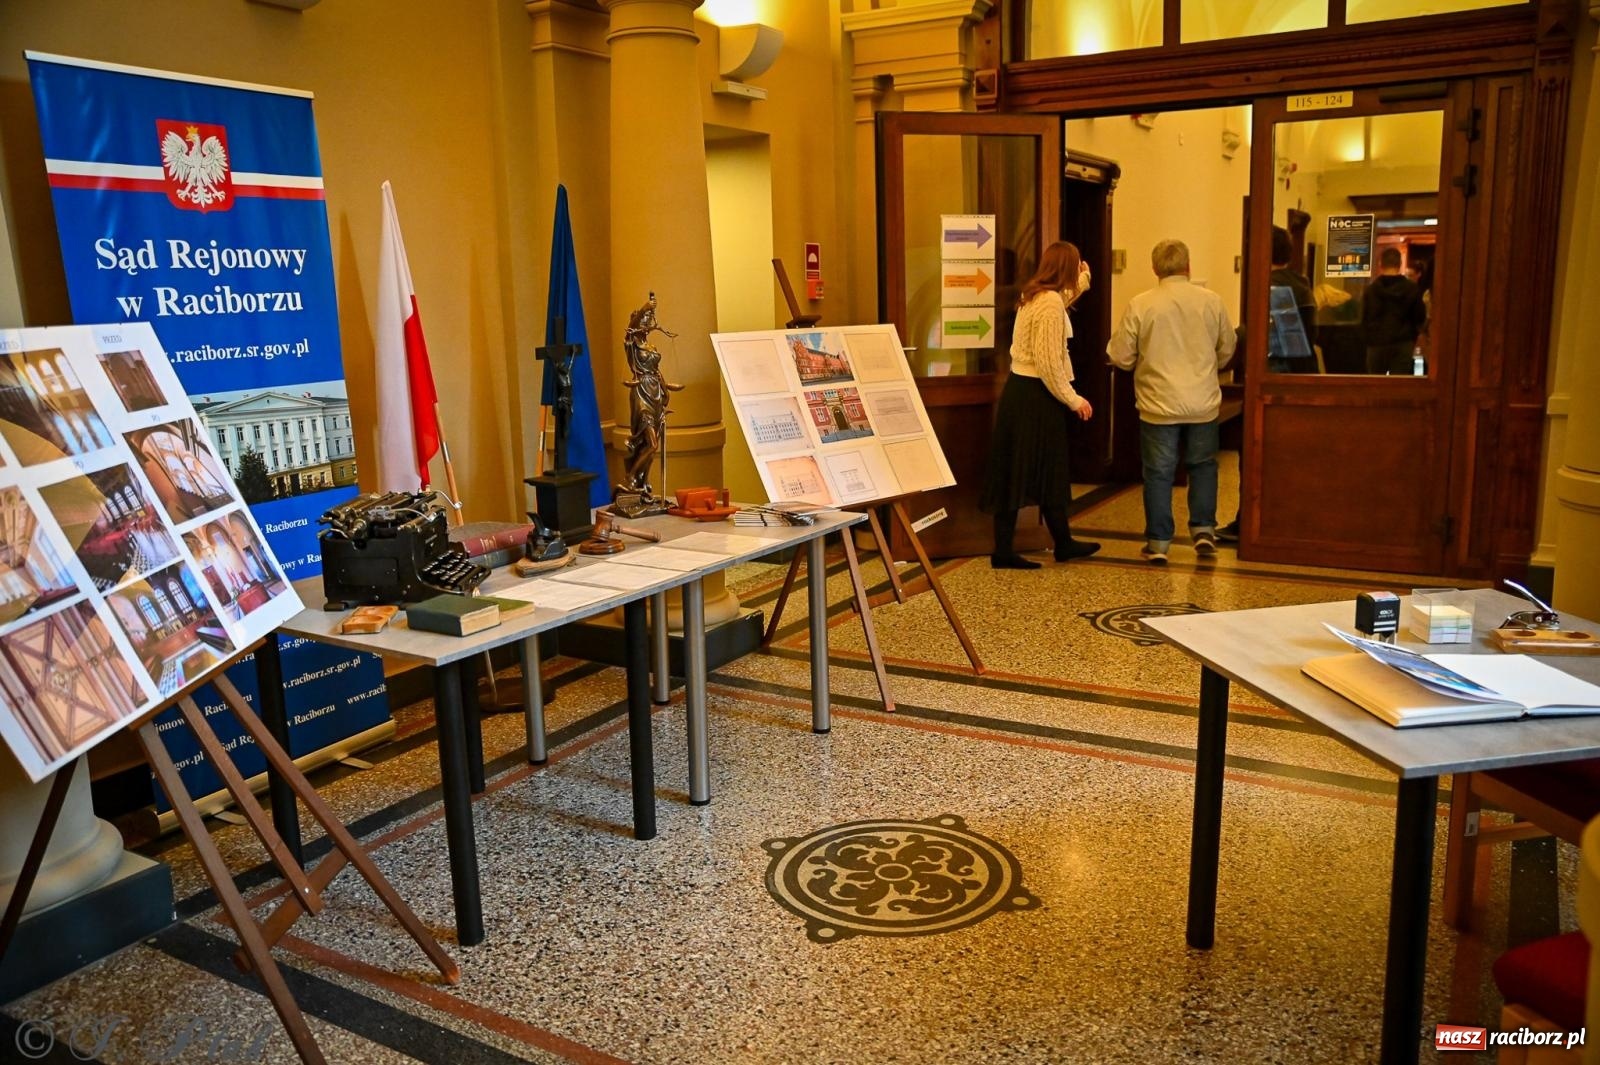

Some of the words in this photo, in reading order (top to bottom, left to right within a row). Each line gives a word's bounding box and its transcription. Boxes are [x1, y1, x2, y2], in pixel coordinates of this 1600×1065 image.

[1296, 96, 1313, 108] 115
[1325, 94, 1343, 106] 124
[95, 238, 158, 275] Sąd
[166, 239, 306, 276] Rejonowy
[117, 296, 142, 318] w
[153, 285, 303, 316] Raciborzu
[265, 518, 308, 534] Raciborzu
[294, 704, 336, 725] Raciborzu
